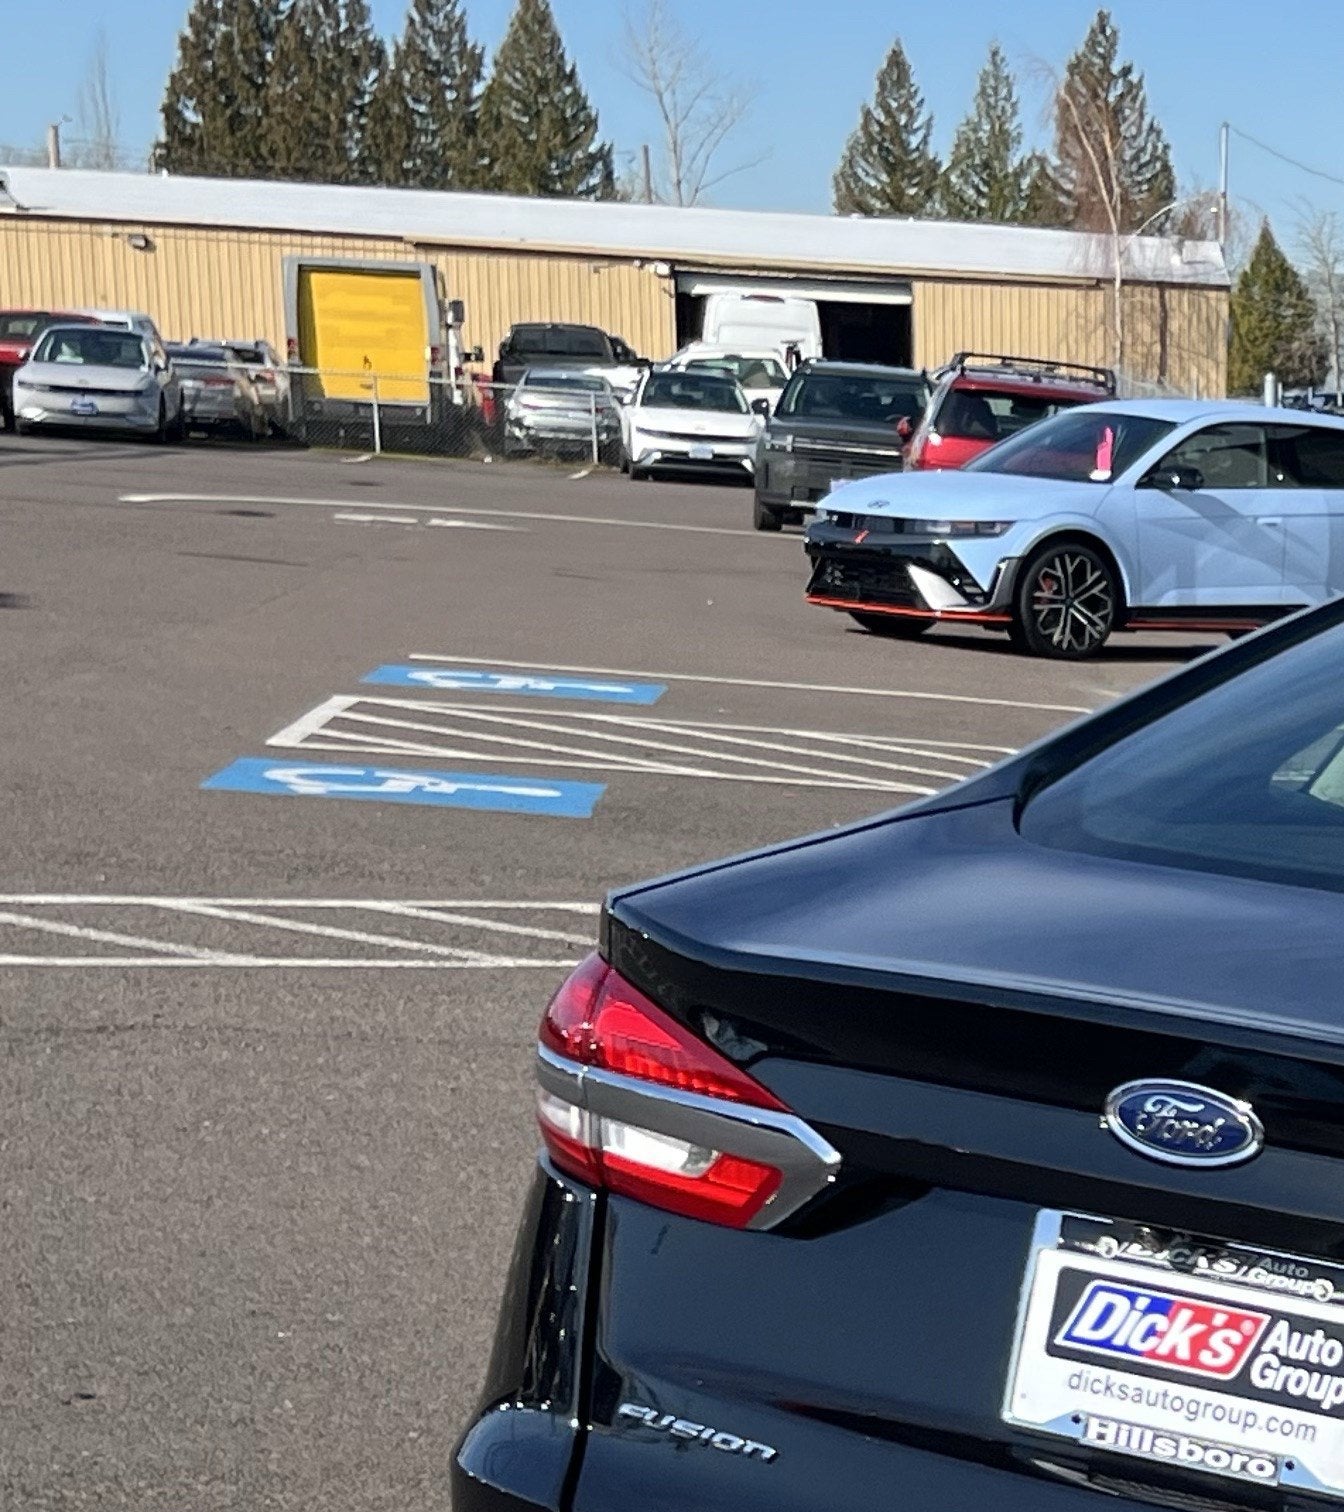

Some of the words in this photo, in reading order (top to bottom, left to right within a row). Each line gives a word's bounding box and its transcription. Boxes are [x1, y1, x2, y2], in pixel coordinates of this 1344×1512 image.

[1136, 1094, 1228, 1150] Ford
[1249, 1267, 1317, 1296] Group
[1257, 1256, 1310, 1279] Auto
[1071, 1290, 1244, 1367] Dick's
[1261, 1319, 1344, 1367] Auto
[1068, 1369, 1317, 1442] dicksautogroup.com
[1084, 1415, 1276, 1479] Hillsboro
